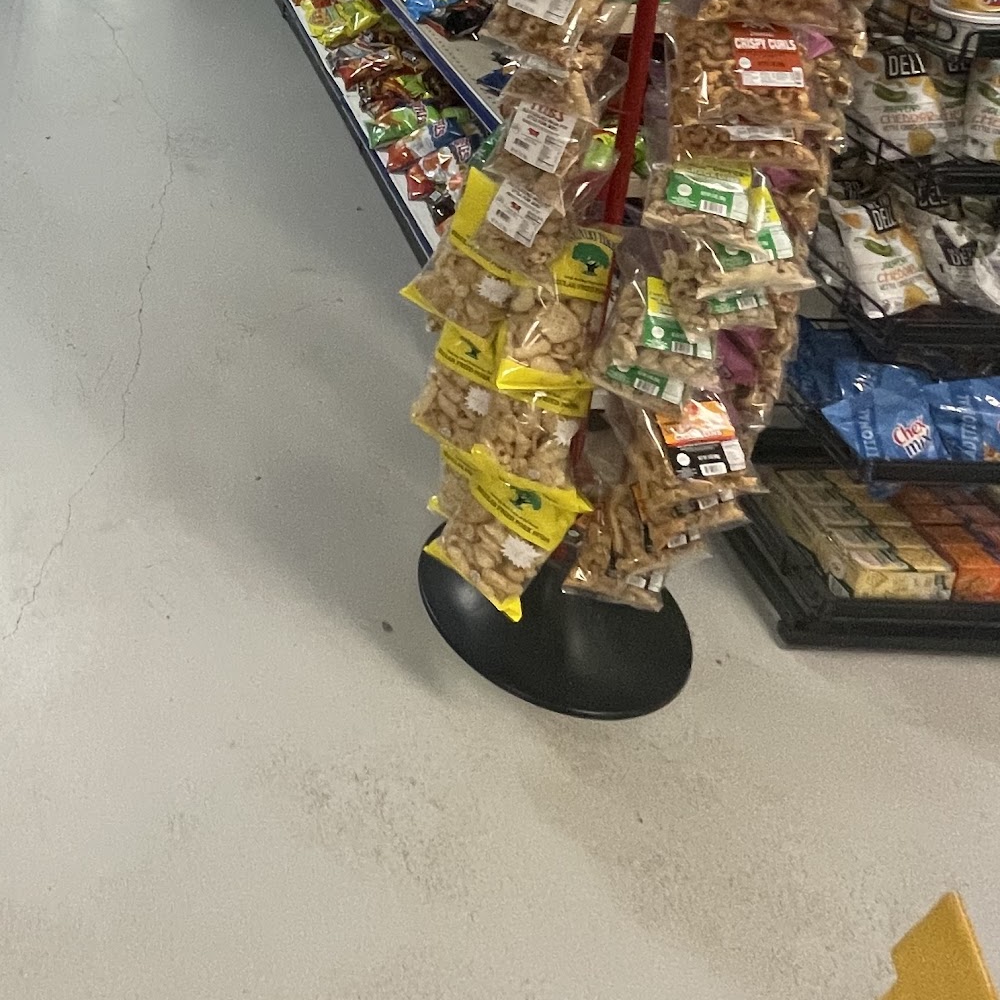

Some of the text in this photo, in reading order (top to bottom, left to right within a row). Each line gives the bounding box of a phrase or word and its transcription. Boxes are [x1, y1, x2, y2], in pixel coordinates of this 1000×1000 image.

[734, 37, 798, 51] CRISPY CURLS
[888, 53, 926, 77] DELI
[893, 415, 929, 446] Chex
